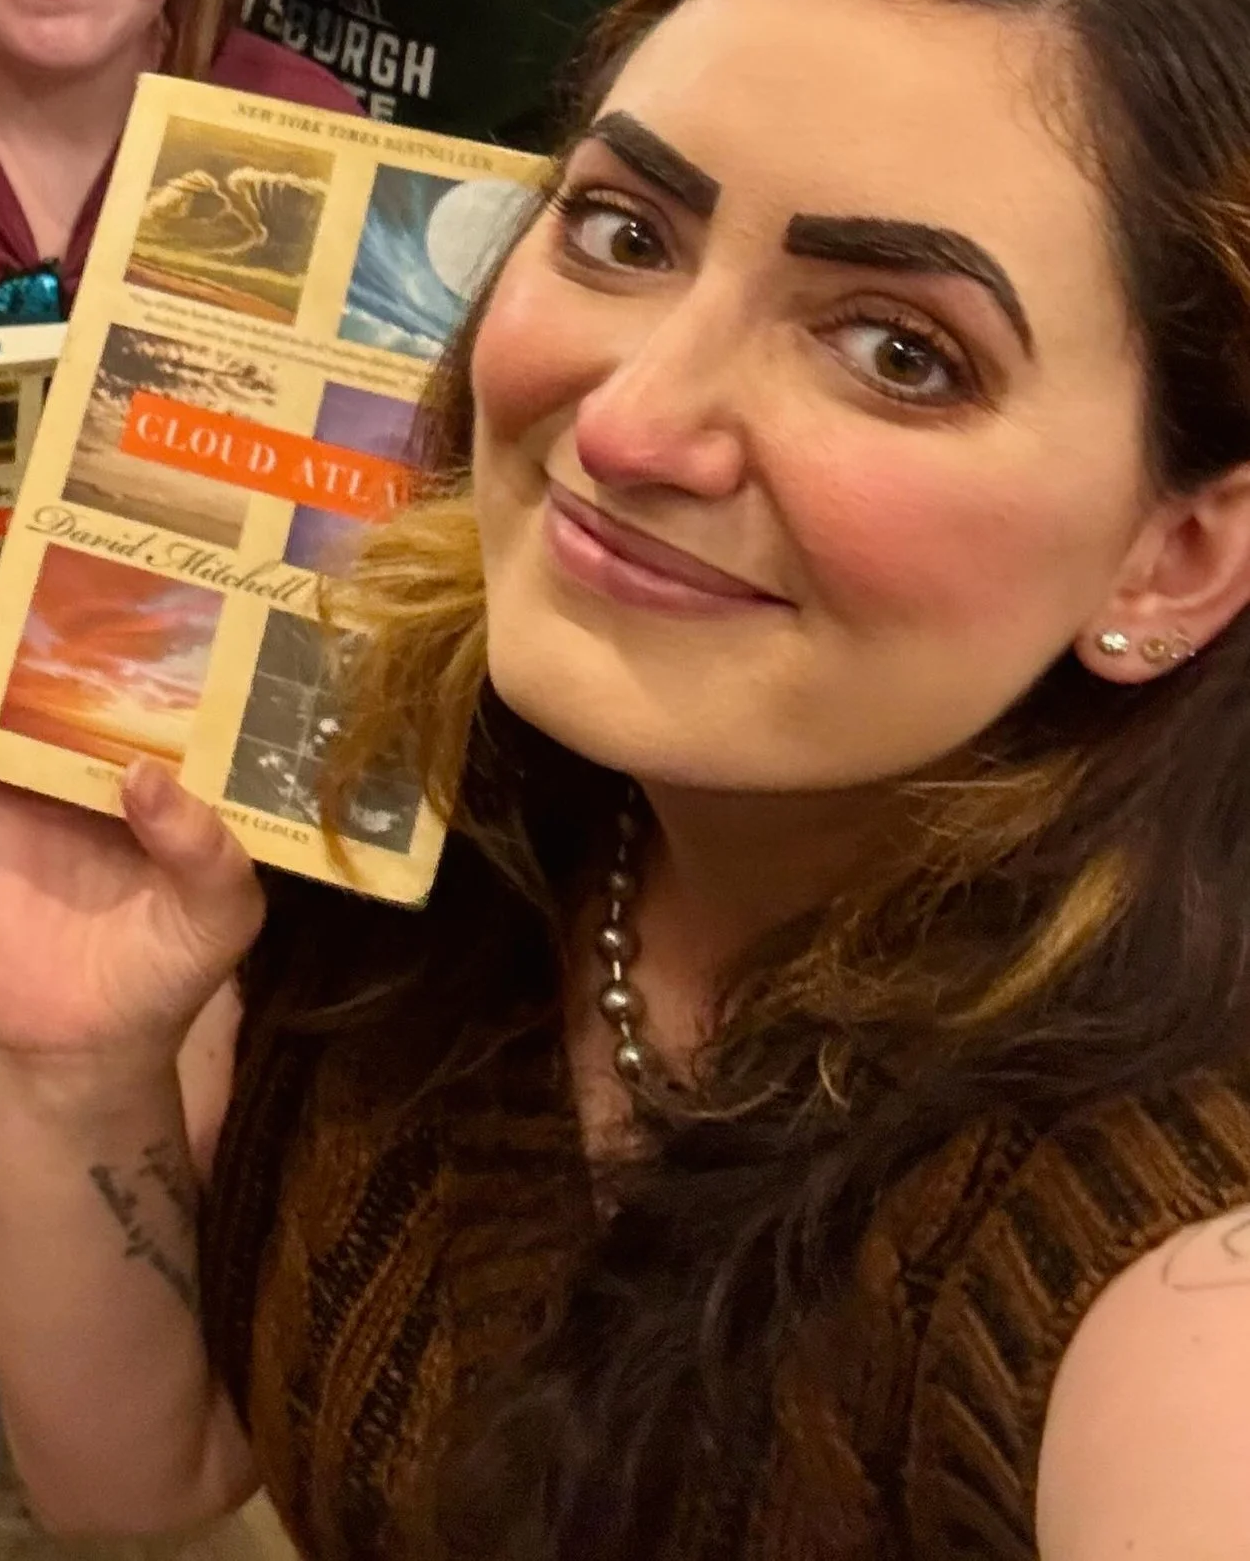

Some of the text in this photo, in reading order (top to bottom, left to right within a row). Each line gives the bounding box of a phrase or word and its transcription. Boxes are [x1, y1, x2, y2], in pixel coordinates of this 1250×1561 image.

[234, 101, 494, 172] NEW YORK TIMES BESTSELLER
[136, 412, 400, 510] CLOUD ATLA
[25, 505, 313, 602] David Mitchell
